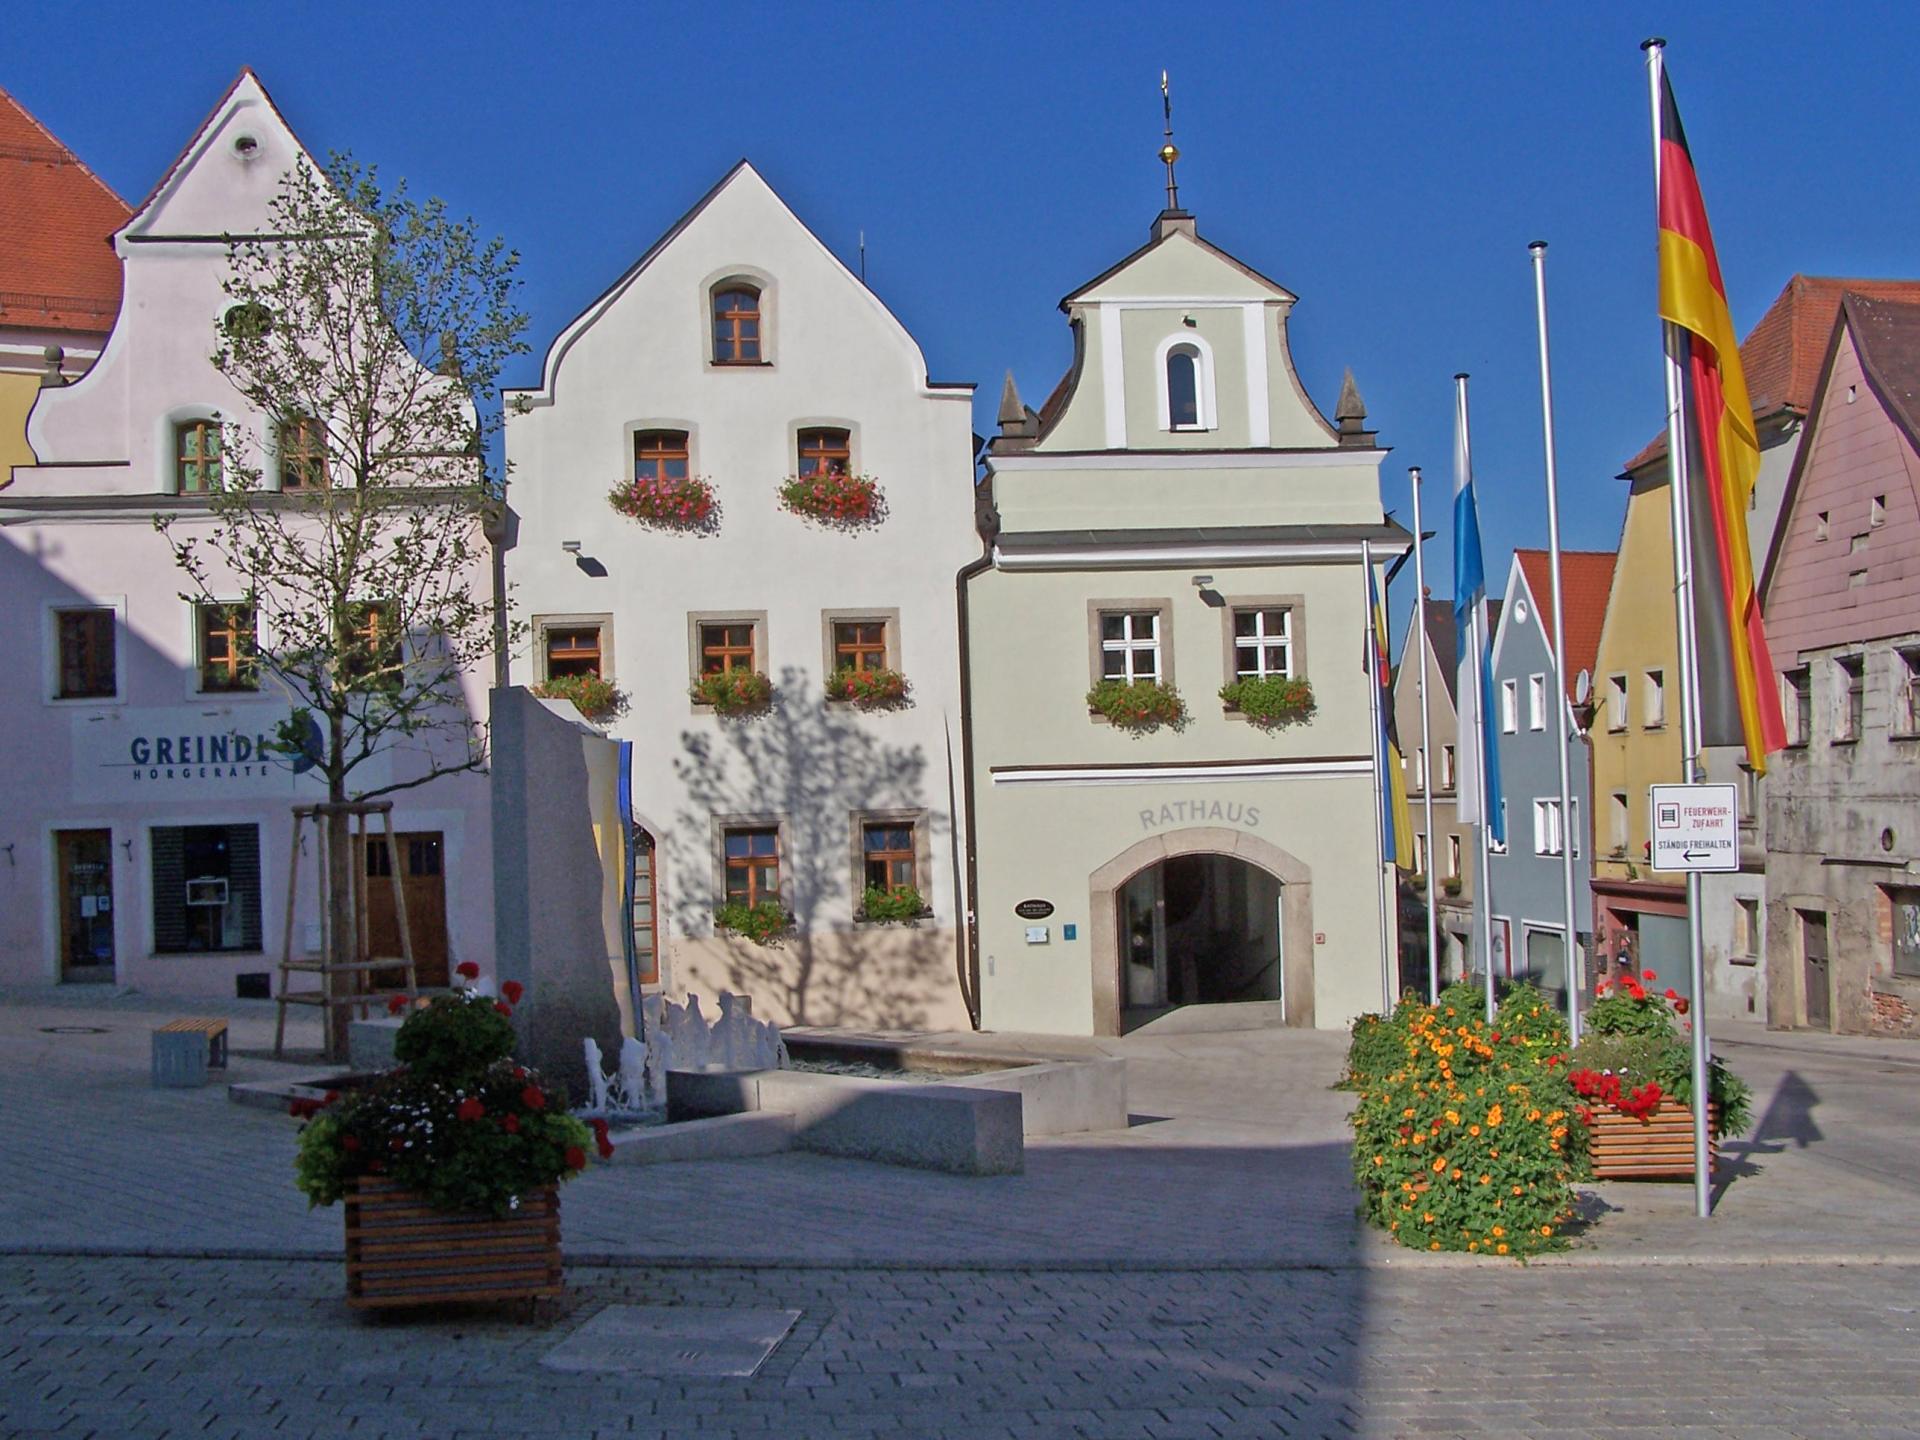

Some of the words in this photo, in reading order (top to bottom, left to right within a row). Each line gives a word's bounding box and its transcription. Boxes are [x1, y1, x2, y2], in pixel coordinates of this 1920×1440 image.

[130, 734, 270, 765] GREINDL
[1138, 799, 1261, 830] RATHAUS
[1683, 807, 1732, 817] FEUERWEHR-
[1692, 818, 1724, 829] ZUFAHRT
[1658, 840, 1687, 850] STÄNDIG
[1689, 840, 1732, 849] FREIHALTEN
